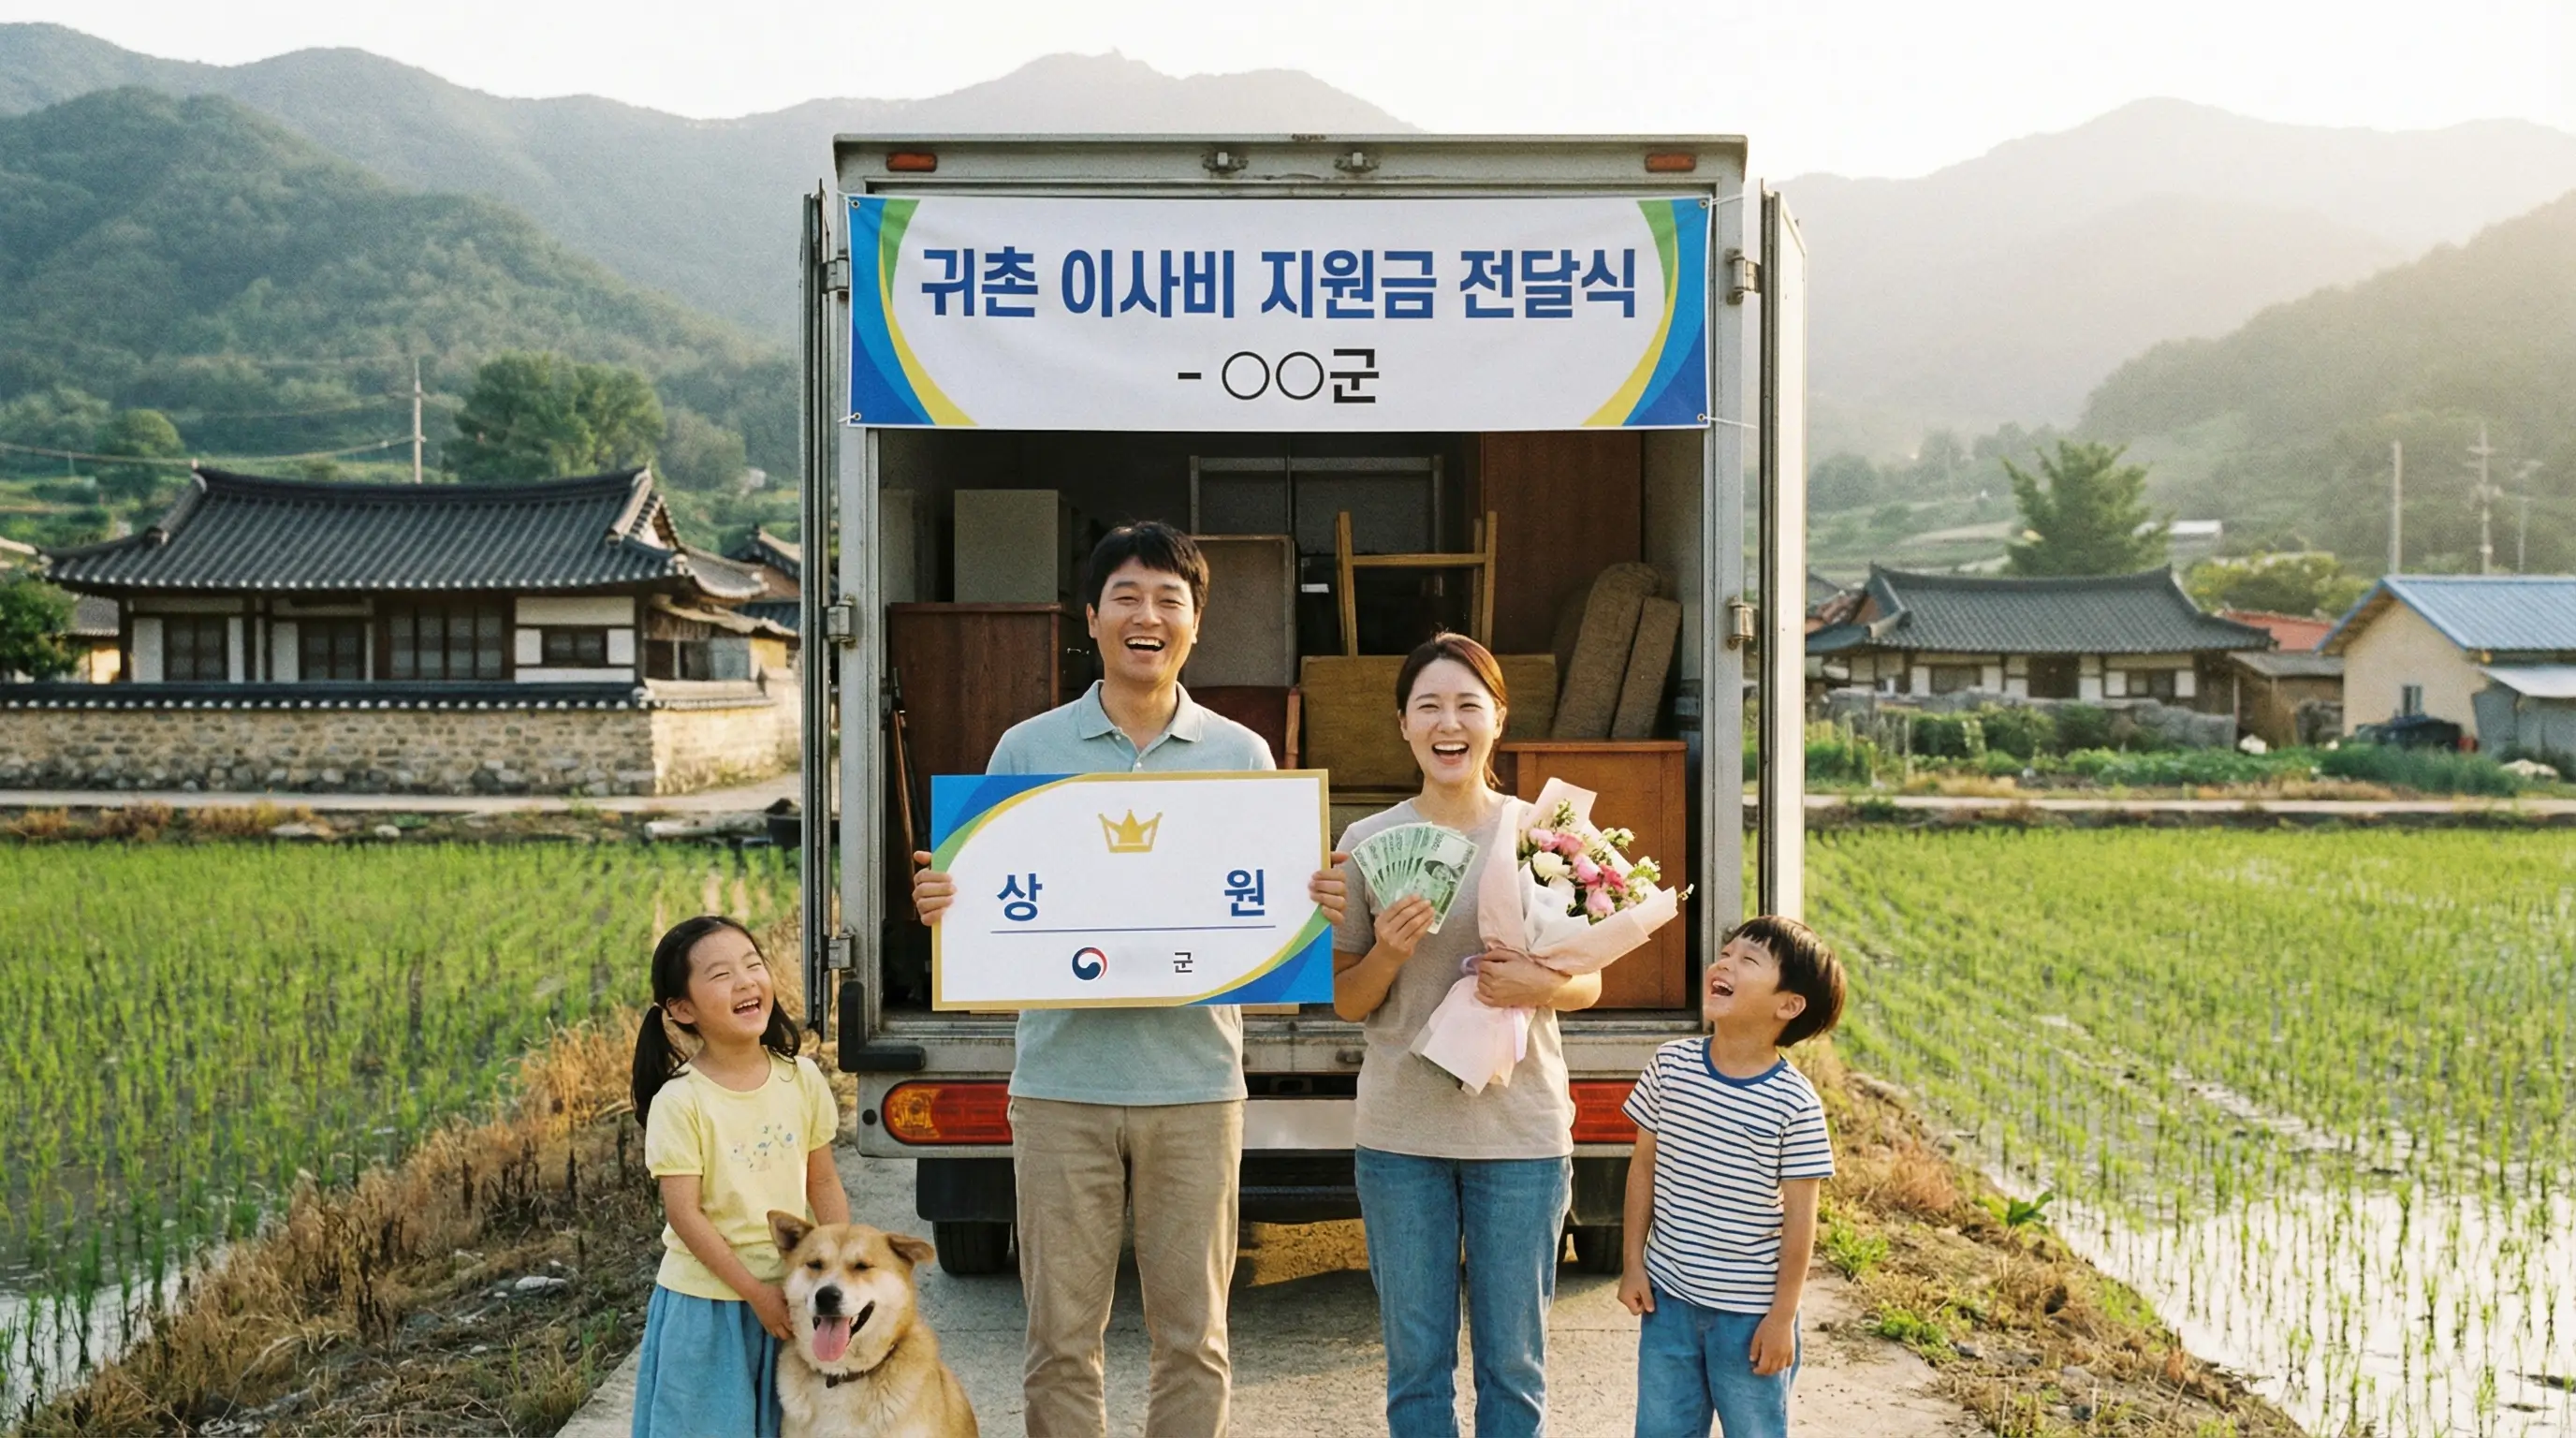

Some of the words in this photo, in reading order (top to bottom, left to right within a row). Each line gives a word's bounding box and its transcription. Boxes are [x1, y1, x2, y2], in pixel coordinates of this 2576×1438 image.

[921, 246, 1039, 318] 귀촌
[1061, 249, 1235, 319] 이사비
[1261, 249, 1438, 319] 지원금
[1459, 248, 1636, 319] 전달식
[996, 873, 1043, 922] 상
[1223, 869, 1266, 917] 원
[1172, 951, 1194, 974] 군
